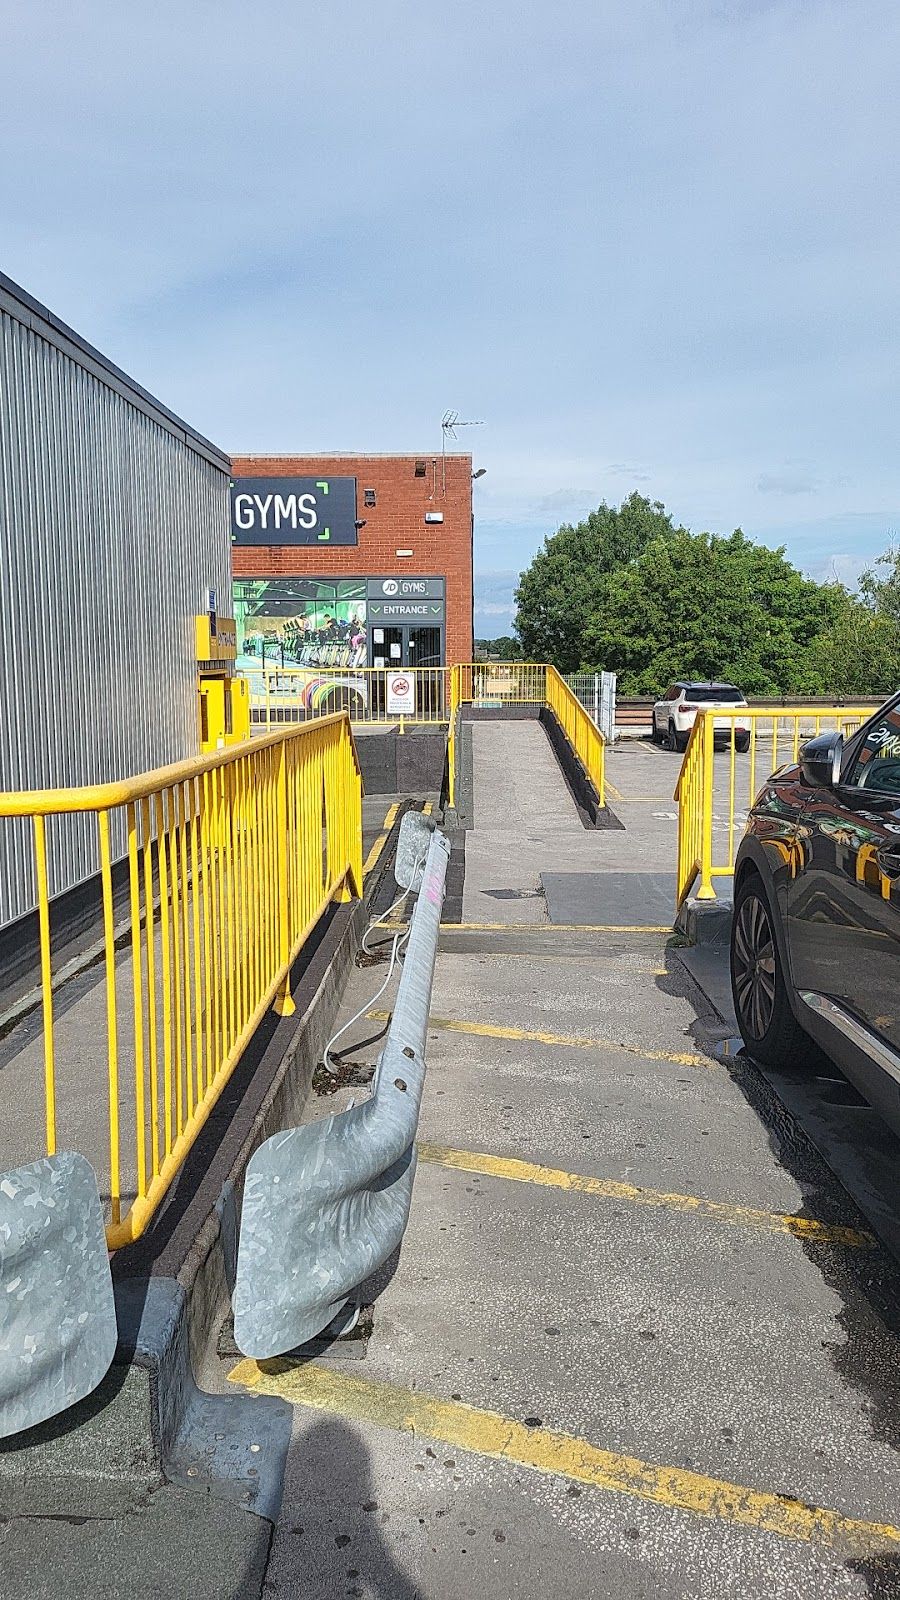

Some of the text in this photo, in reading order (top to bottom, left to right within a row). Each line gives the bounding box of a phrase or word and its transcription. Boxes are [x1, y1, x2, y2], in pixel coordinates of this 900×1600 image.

[235, 493, 317, 529] GYMS
[402, 582, 426, 593] GYMS
[383, 605, 428, 614] ENTRANCE
